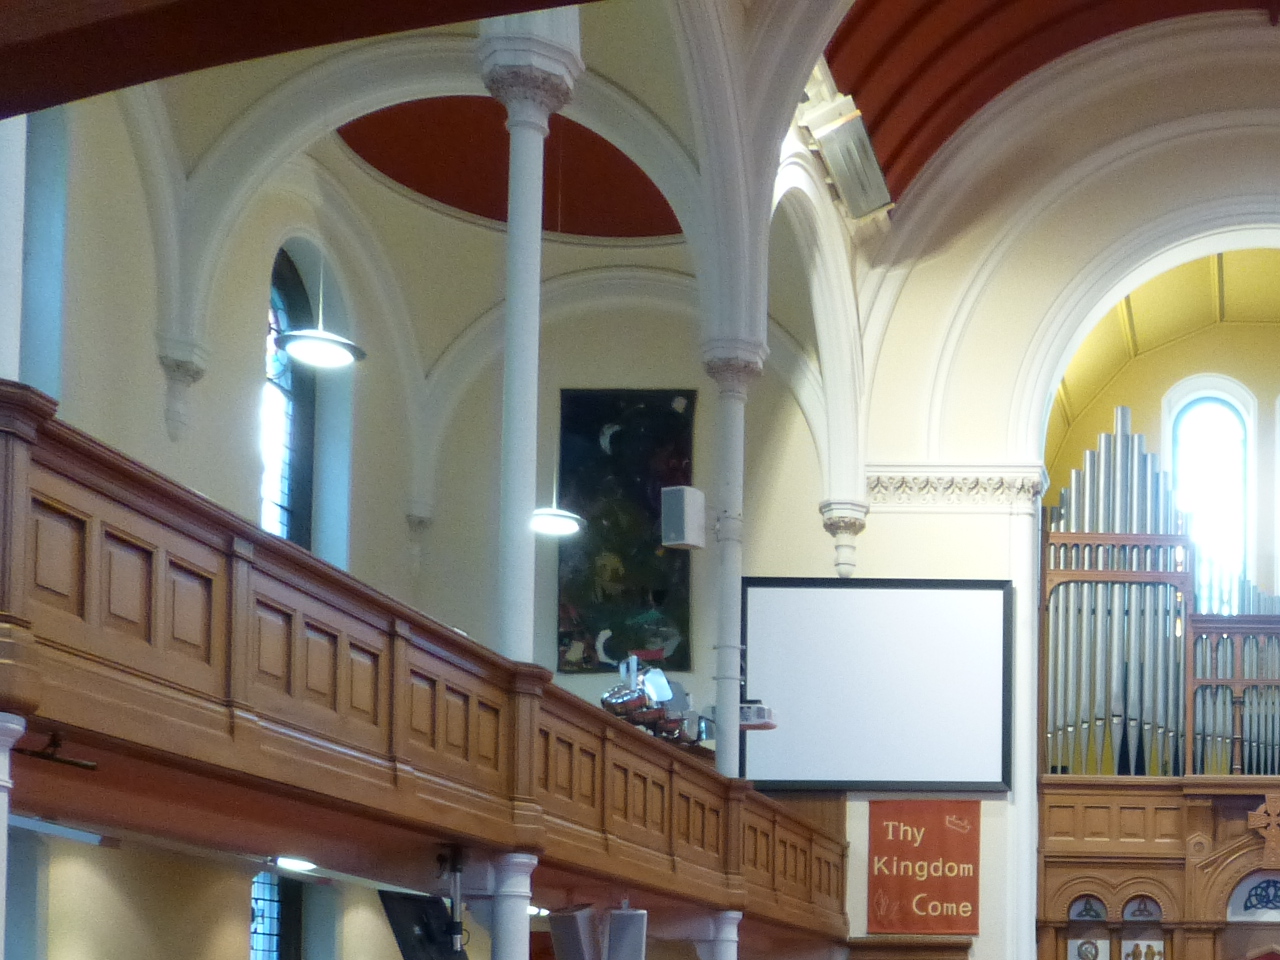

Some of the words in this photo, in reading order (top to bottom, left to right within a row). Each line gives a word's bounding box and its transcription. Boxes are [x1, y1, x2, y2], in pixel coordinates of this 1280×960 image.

[883, 821, 926, 847] Thy
[873, 856, 974, 881] Kingdom
[912, 893, 973, 917] Come
